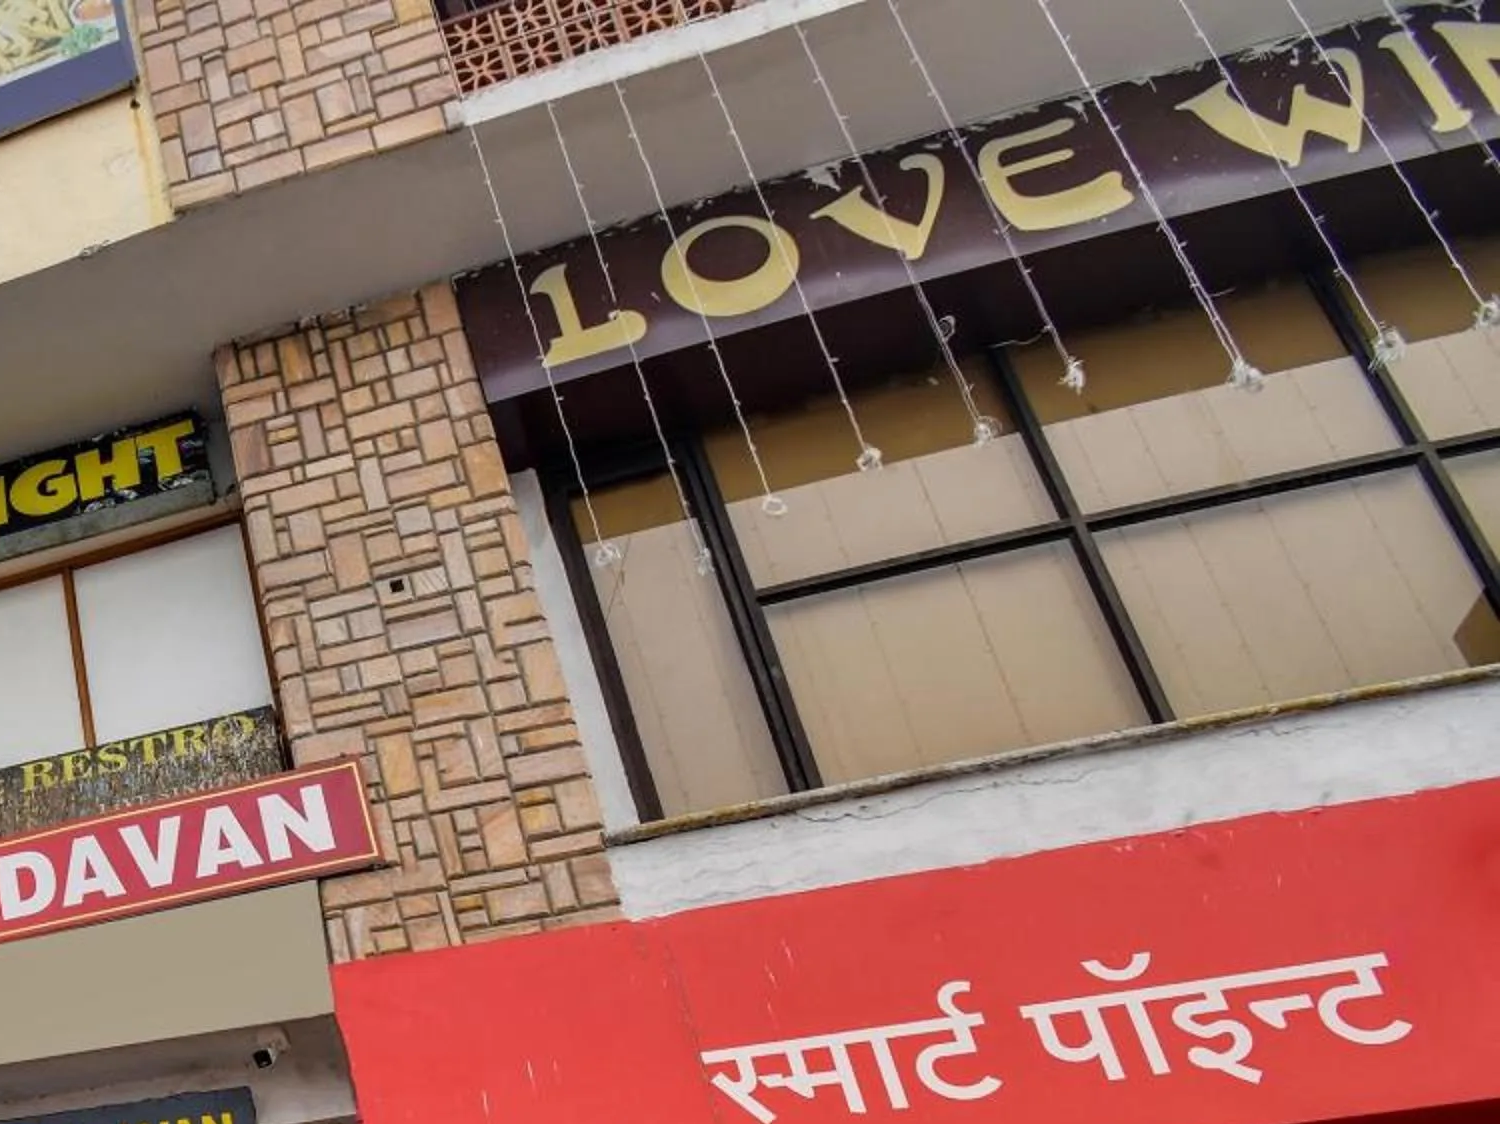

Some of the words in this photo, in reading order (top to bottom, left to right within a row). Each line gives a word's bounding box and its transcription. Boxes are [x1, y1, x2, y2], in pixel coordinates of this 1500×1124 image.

[529, 118, 1135, 366] LOVE
[20, 715, 256, 794] RESTRO
[1020, 952, 1412, 1084] पॉइन्ट
